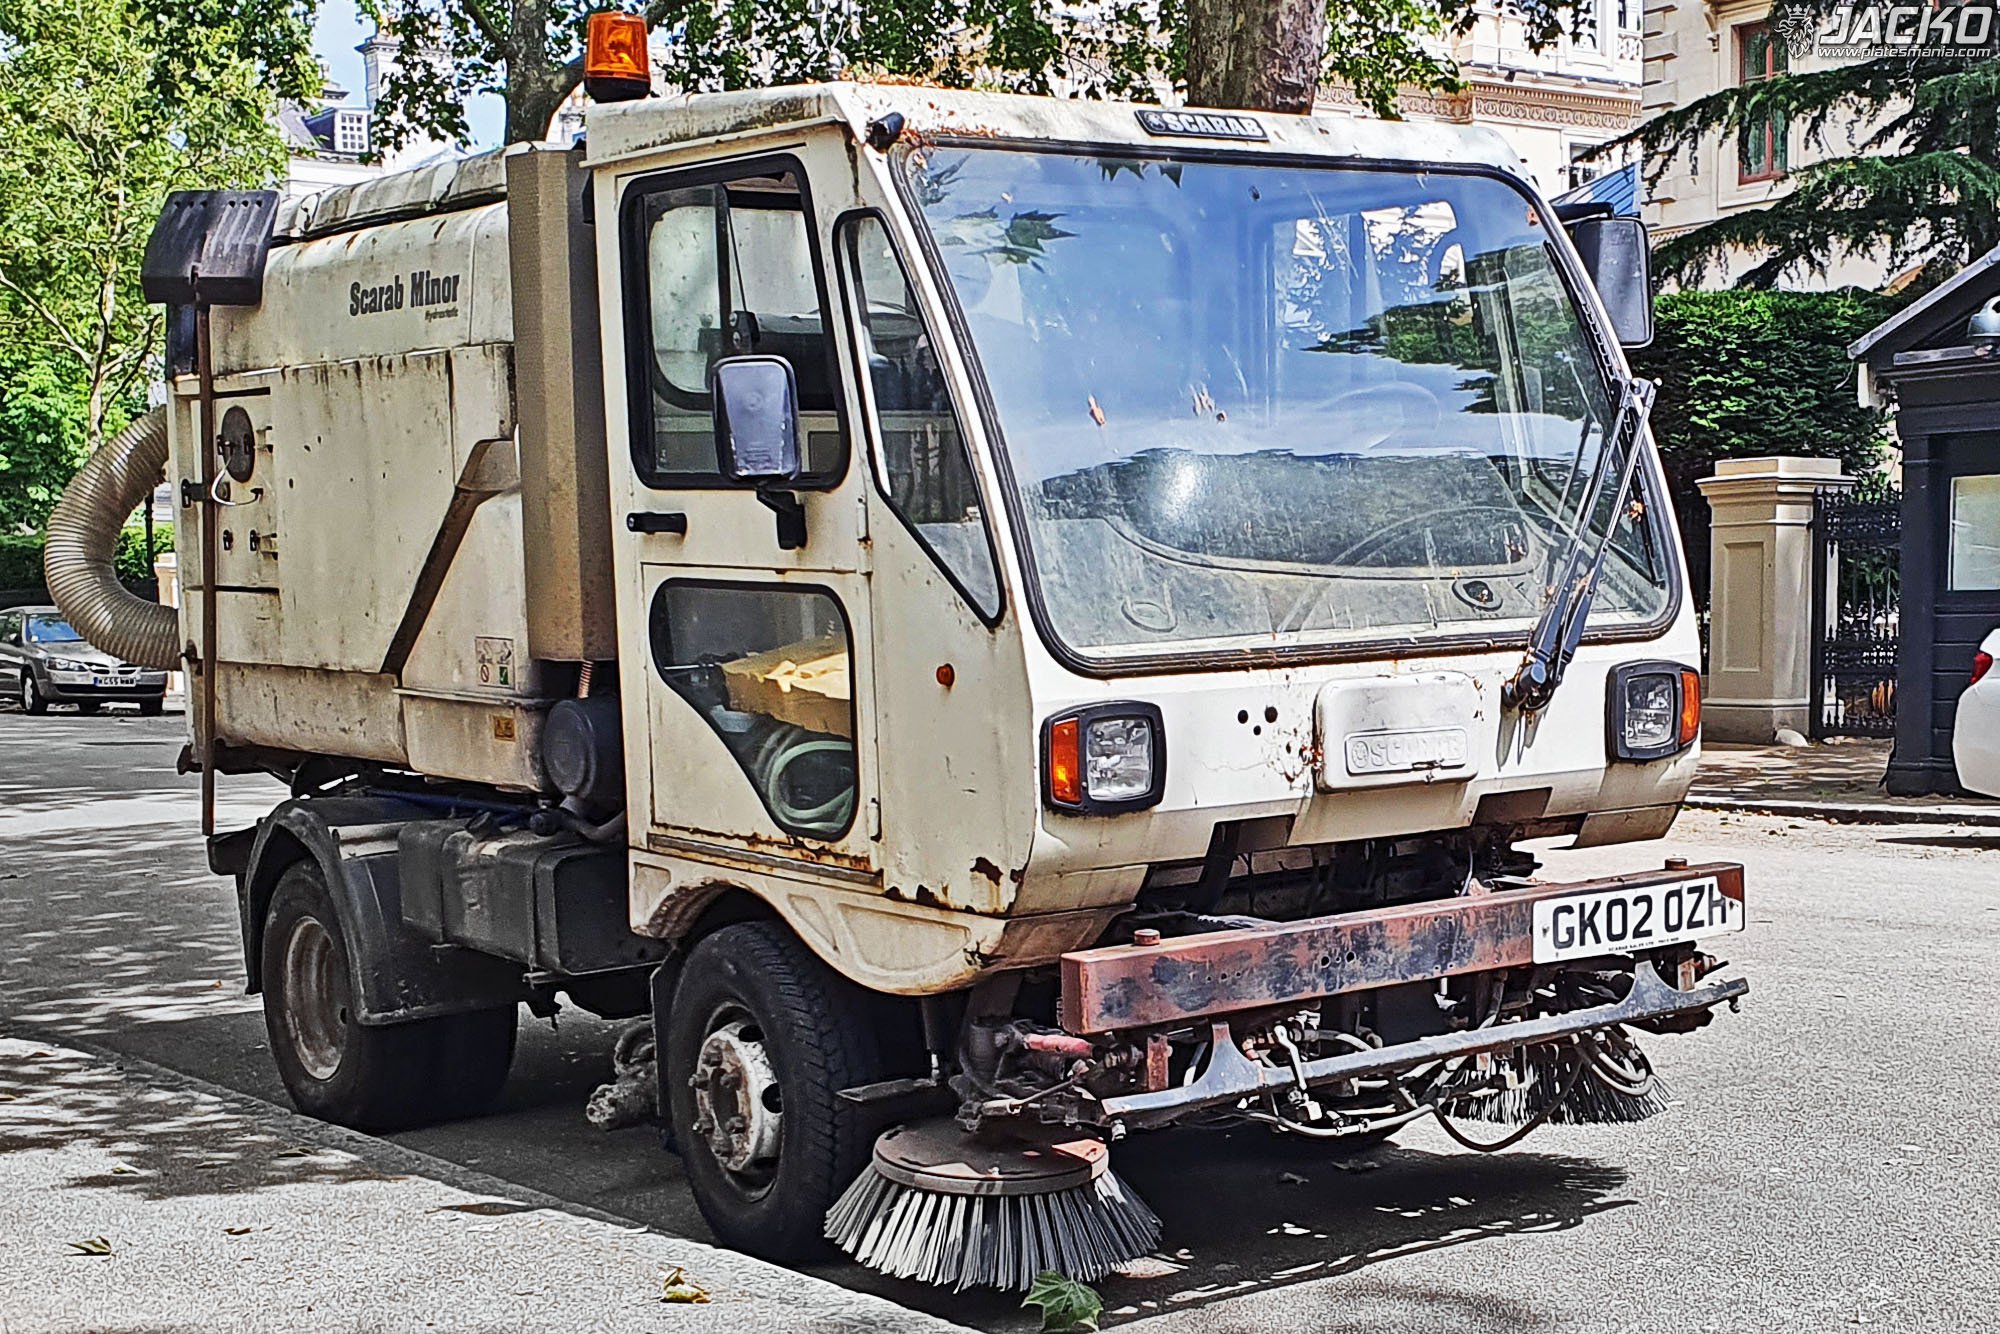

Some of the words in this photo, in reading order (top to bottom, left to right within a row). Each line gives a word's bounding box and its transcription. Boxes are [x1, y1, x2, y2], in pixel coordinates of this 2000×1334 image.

[1162, 112, 1264, 137] SCARAB
[350, 275, 404, 316] Scarab
[410, 270, 460, 308] Minor
[1552, 894, 1653, 950] GK02
[1664, 883, 1727, 933] OZH
